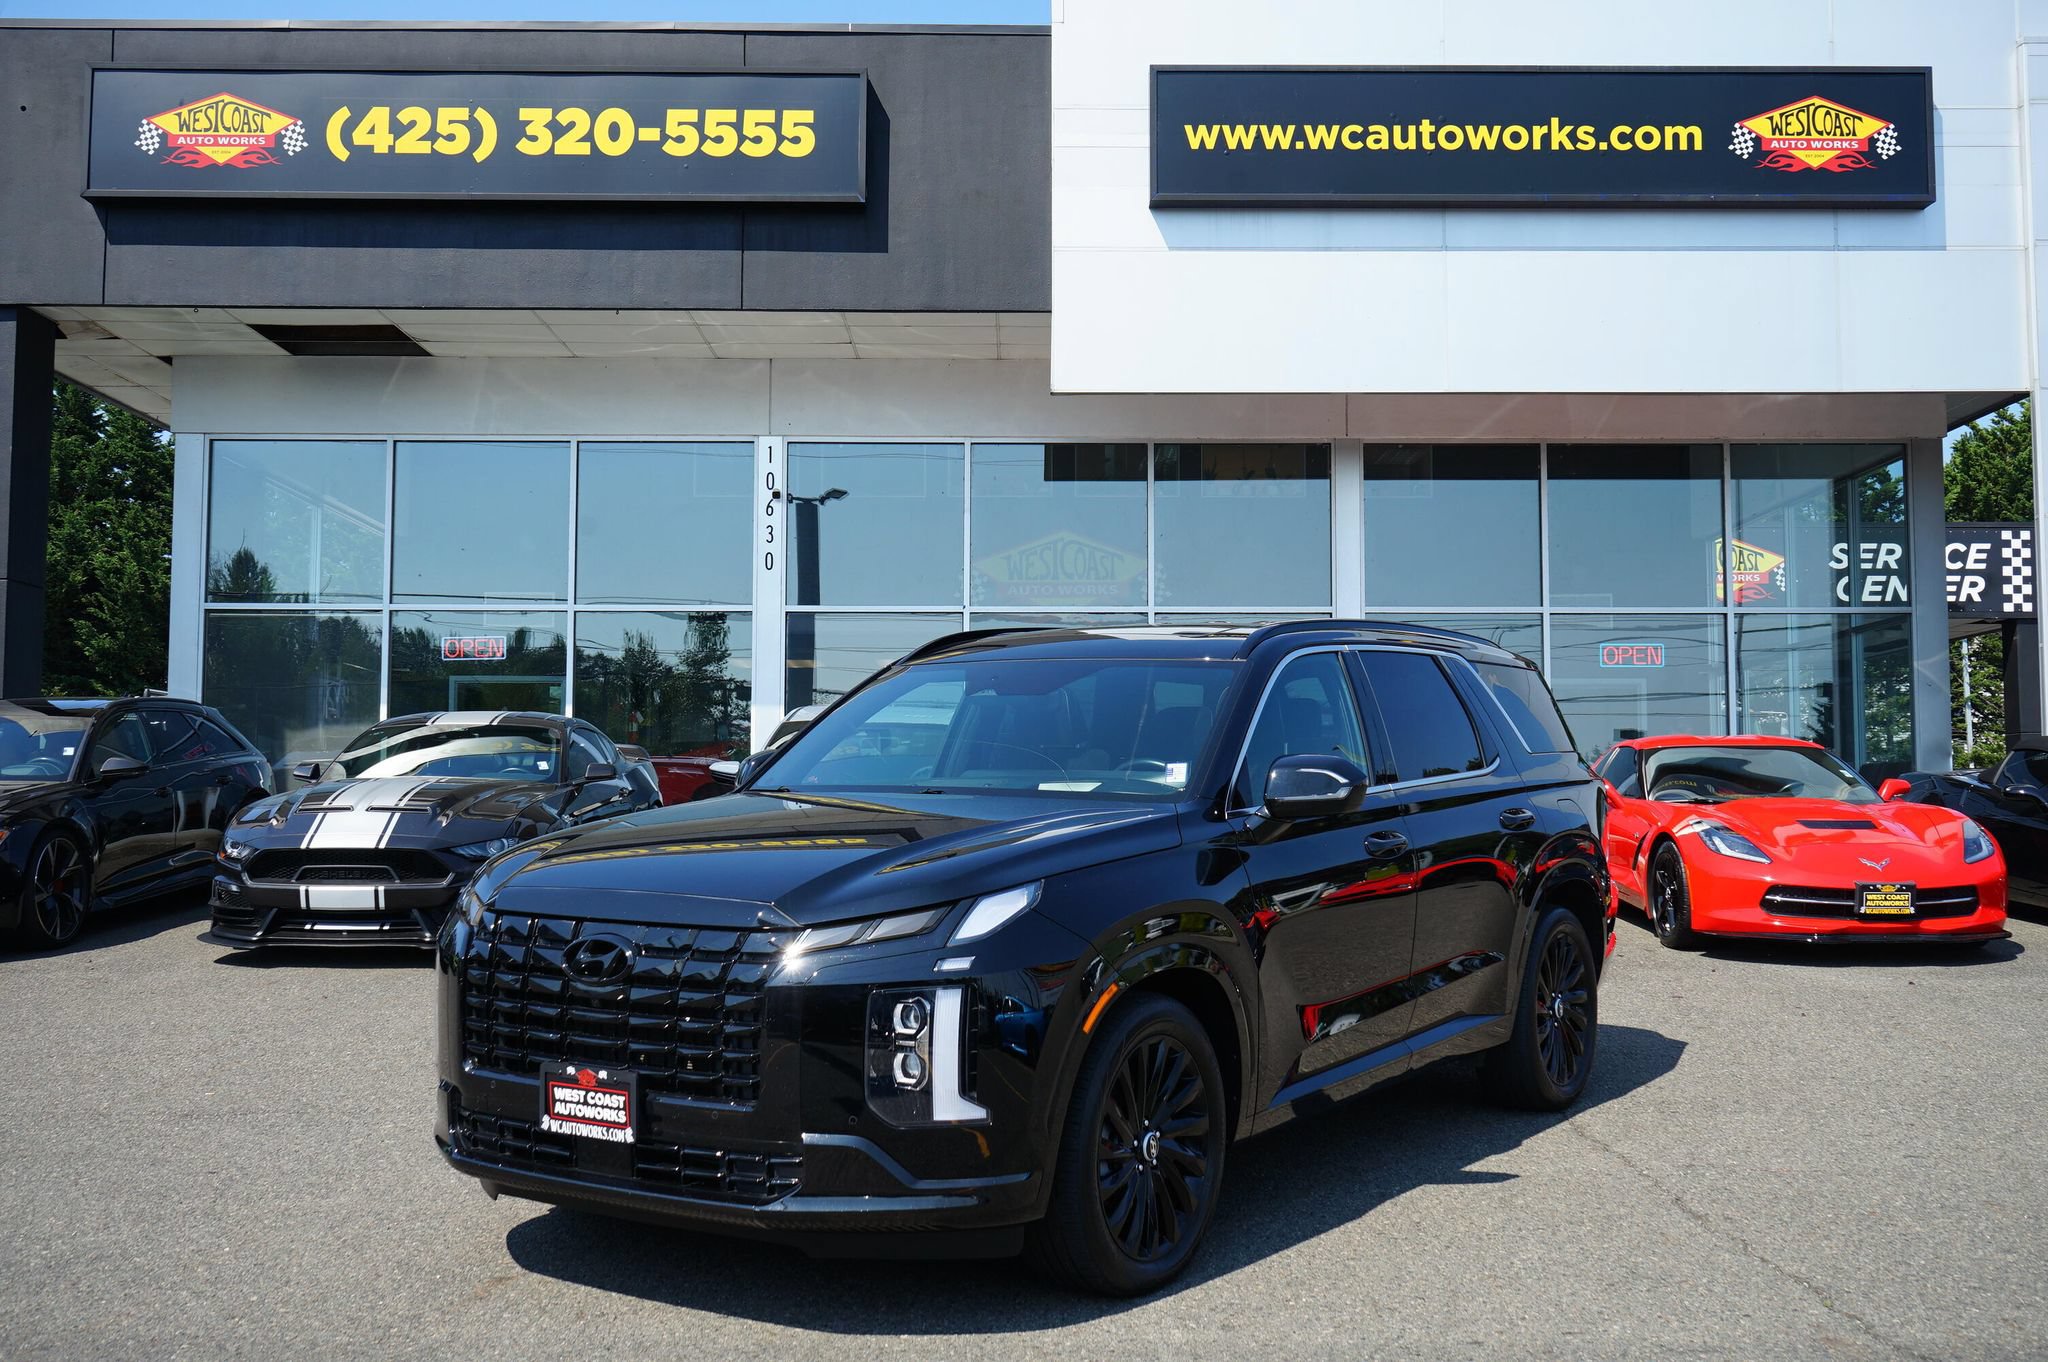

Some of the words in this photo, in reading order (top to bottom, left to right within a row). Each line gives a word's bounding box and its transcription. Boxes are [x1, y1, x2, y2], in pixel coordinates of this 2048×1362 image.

[177, 136, 214, 145] AUTO
[217, 136, 266, 145] WORKS
[326, 105, 497, 162] (425)
[515, 107, 816, 158] 320-5555
[1184, 117, 1703, 151] www.wcautoworks.com
[1771, 140, 1807, 149] AUTO
[1811, 140, 1859, 149] WORKS
[765, 445, 775, 571] 10630
[1008, 584, 1055, 596] AUTO
[1058, 584, 1119, 596] WORKS
[445, 639, 503, 658] OPEN
[1603, 646, 1662, 665] OPEN
[554, 1087, 586, 1102] WEST
[587, 1091, 625, 1109] COAST
[554, 1101, 626, 1123] AUTOWORKS
[550, 1119, 625, 1143] WCAUTOWORKS.COM
